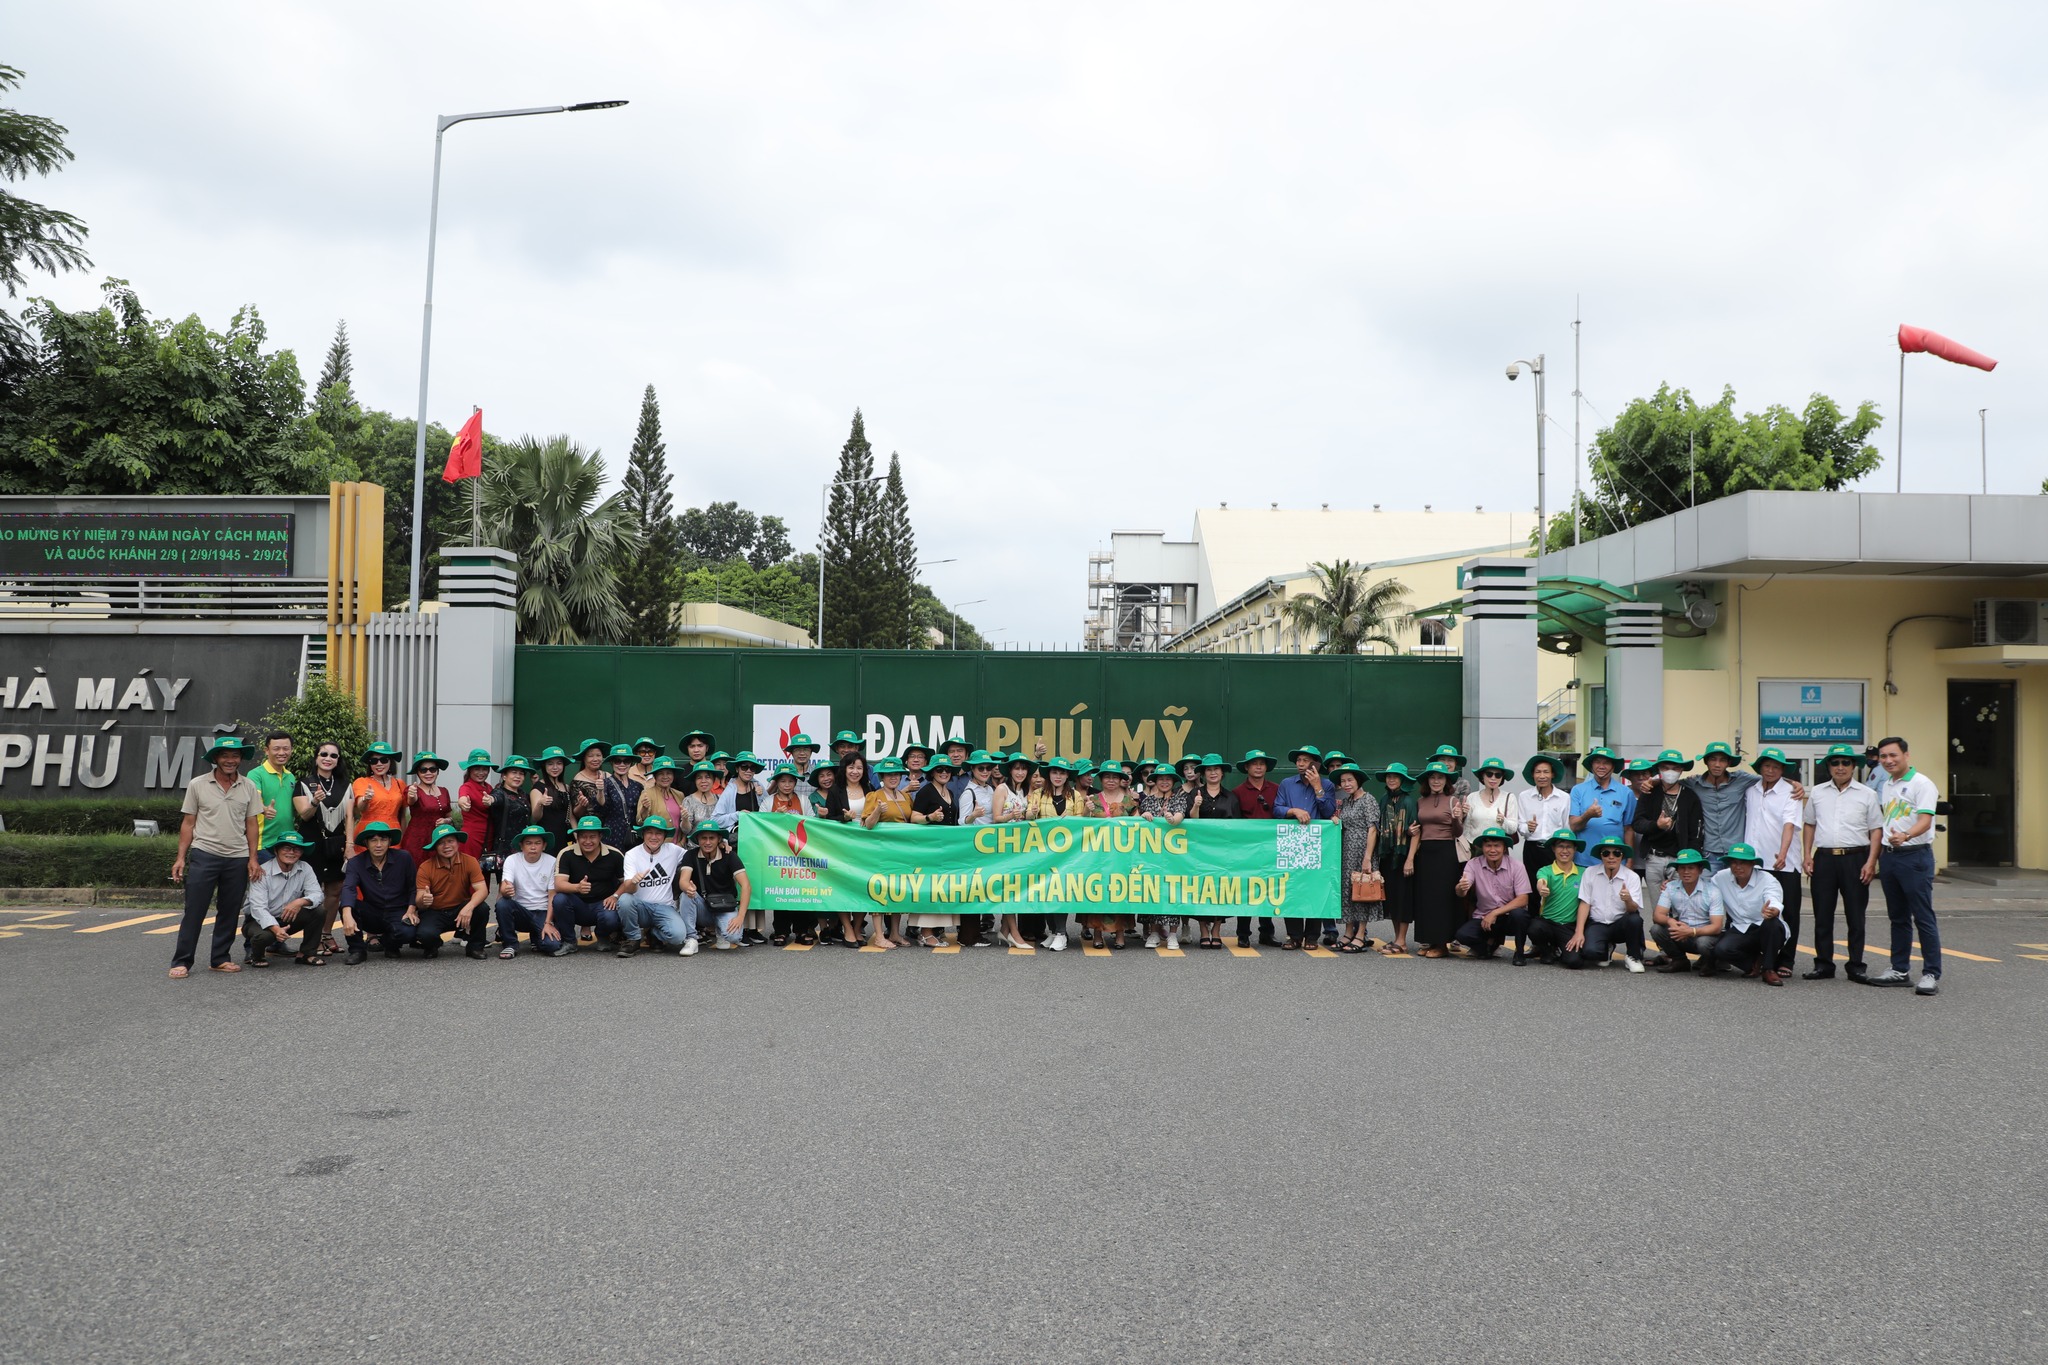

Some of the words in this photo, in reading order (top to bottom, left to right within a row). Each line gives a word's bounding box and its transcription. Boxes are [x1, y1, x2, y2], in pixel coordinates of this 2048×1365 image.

[18, 527, 59, 541] MỪNG
[84, 527, 117, 544] NIỆM
[121, 530, 135, 541] 79
[138, 528, 169, 541] NĂM
[172, 527, 210, 541] NGÀY
[214, 527, 252, 541] CÁCH
[45, 546, 64, 560] VÀ
[109, 546, 157, 560] KHÁNH
[160, 549, 178, 560] 2/9
[190, 549, 241, 561] 2/9/1945
[75, 668, 192, 711] MÁY
[1779, 715, 1802, 725] ĐẠM
[985, 703, 1093, 765] PHÚ
[1110, 706, 1193, 765] MỸ
[1829, 726, 1858, 736] KHÁCH
[974, 822, 1073, 854] CHÀO
[1081, 820, 1188, 855] MỪNG
[768, 855, 828, 869] PETROVIETNAM
[781, 868, 817, 880] PVFCCo
[639, 877, 671, 888] adidas
[801, 886, 818, 896] PHÚ
[820, 886, 833, 896] MỸ
[867, 867, 922, 906] QUÝ
[930, 867, 1021, 904] KHÁCH
[1027, 867, 1103, 904] HÀNG
[1108, 864, 1160, 903] ĐẾN
[1165, 874, 1241, 906] THAM
[1248, 872, 1290, 916] DỰ
